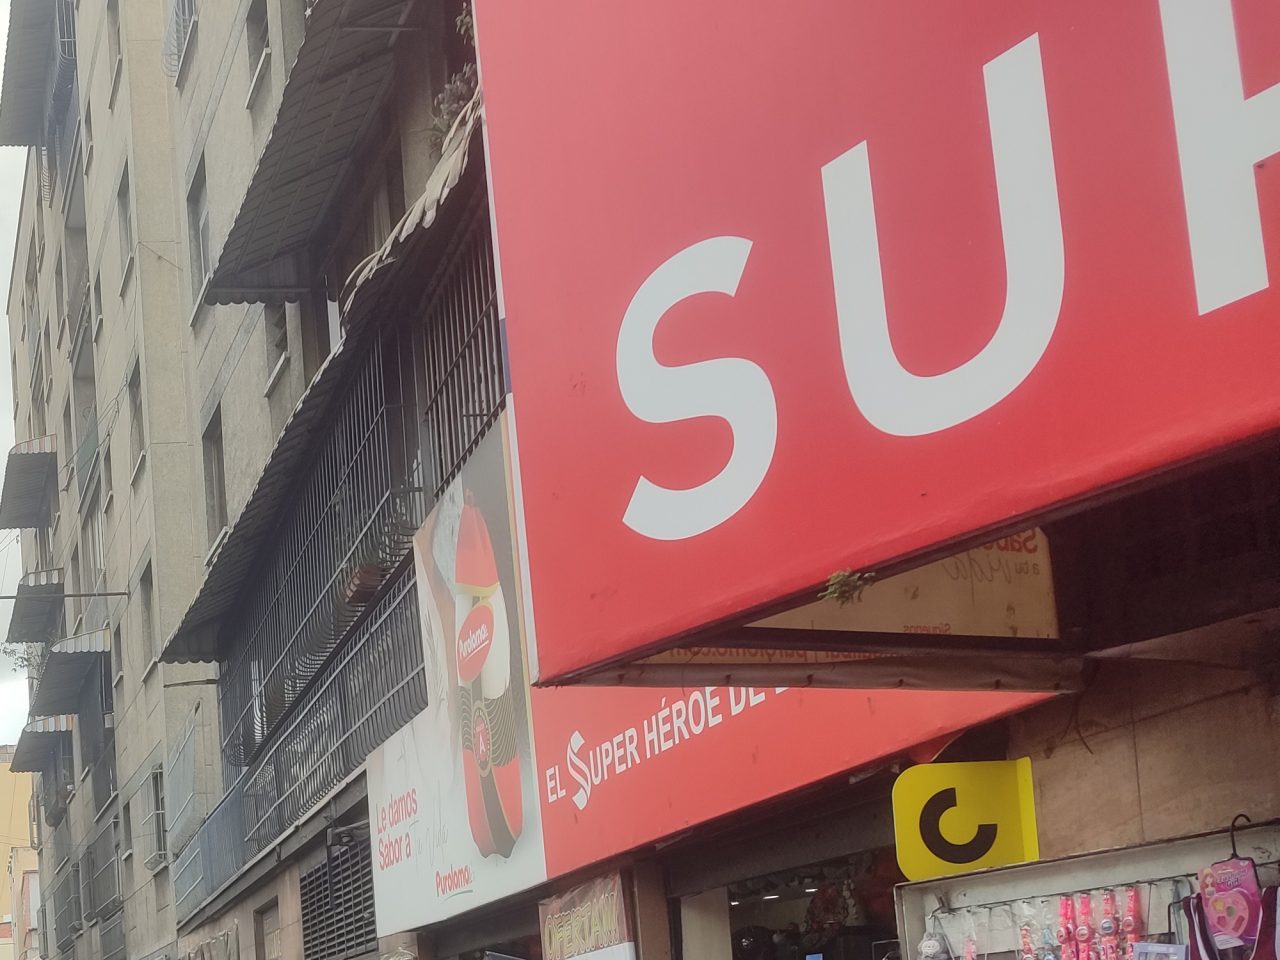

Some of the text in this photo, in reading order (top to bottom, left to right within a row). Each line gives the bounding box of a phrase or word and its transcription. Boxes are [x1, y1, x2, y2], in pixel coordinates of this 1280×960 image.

[546, 765, 566, 804] EL
[643, 687, 722, 759] HÉROE
[376, 787, 418, 835] Le damos
[378, 833, 403, 871] Sabor
[405, 832, 412, 859] a
